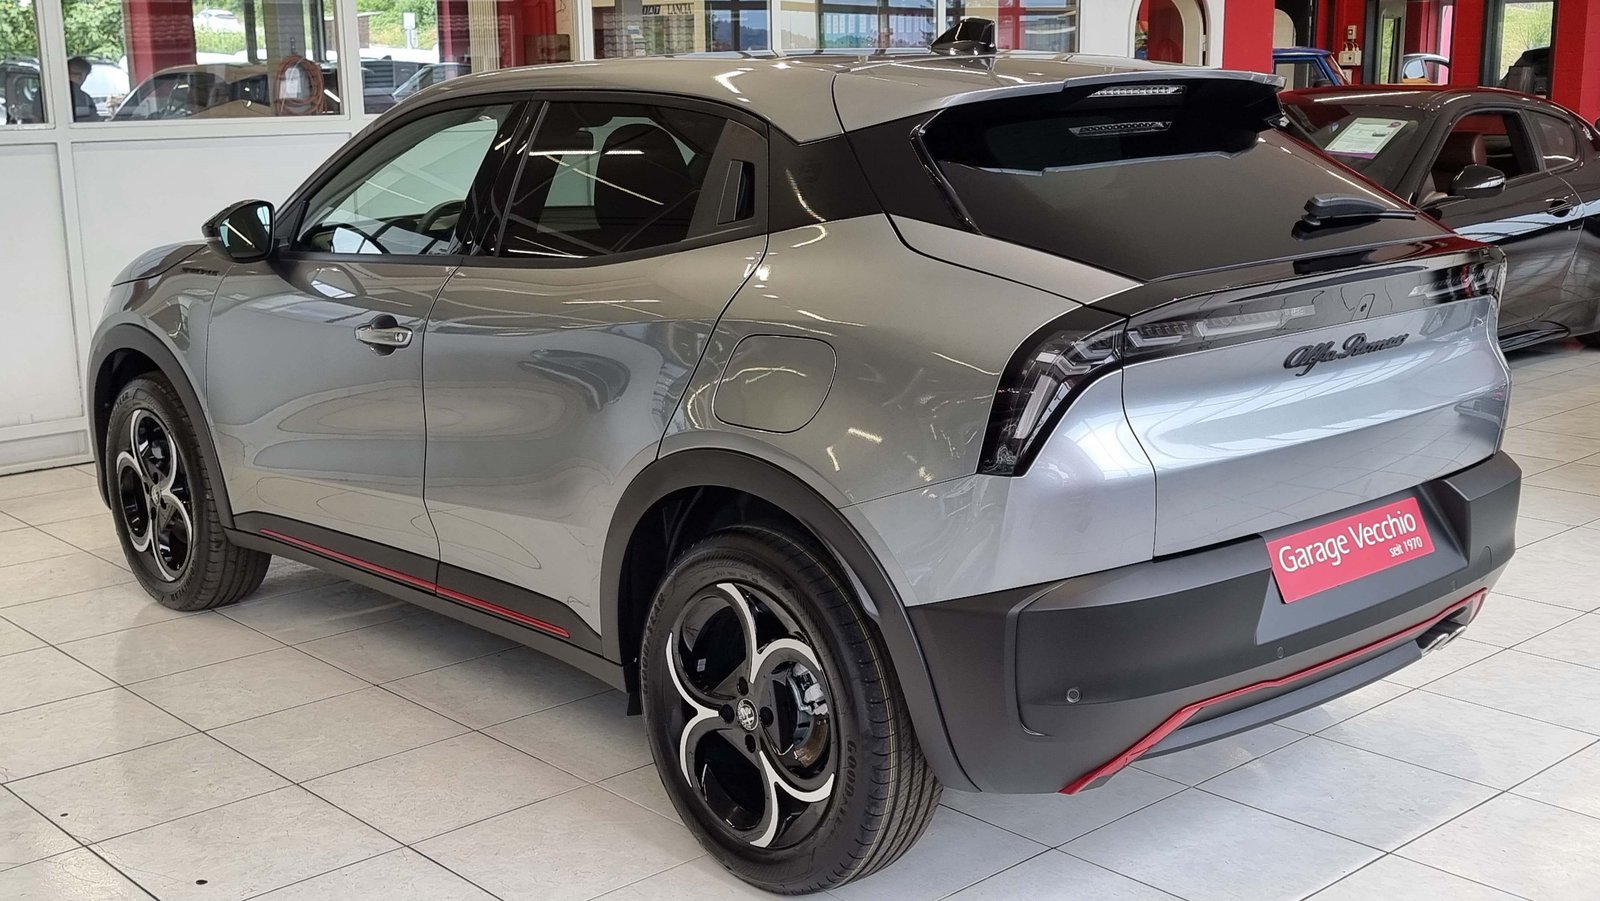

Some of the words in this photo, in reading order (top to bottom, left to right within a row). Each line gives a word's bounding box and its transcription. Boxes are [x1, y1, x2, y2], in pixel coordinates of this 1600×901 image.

[667, 4, 692, 15] LANCIA
[1283, 341, 1338, 377] Alfa
[1340, 333, 1410, 358] Romeo
[1278, 535, 1350, 572] Garage
[1348, 510, 1417, 549] Vecchio
[1389, 543, 1404, 558] seit
[1404, 536, 1423, 552] 1970
